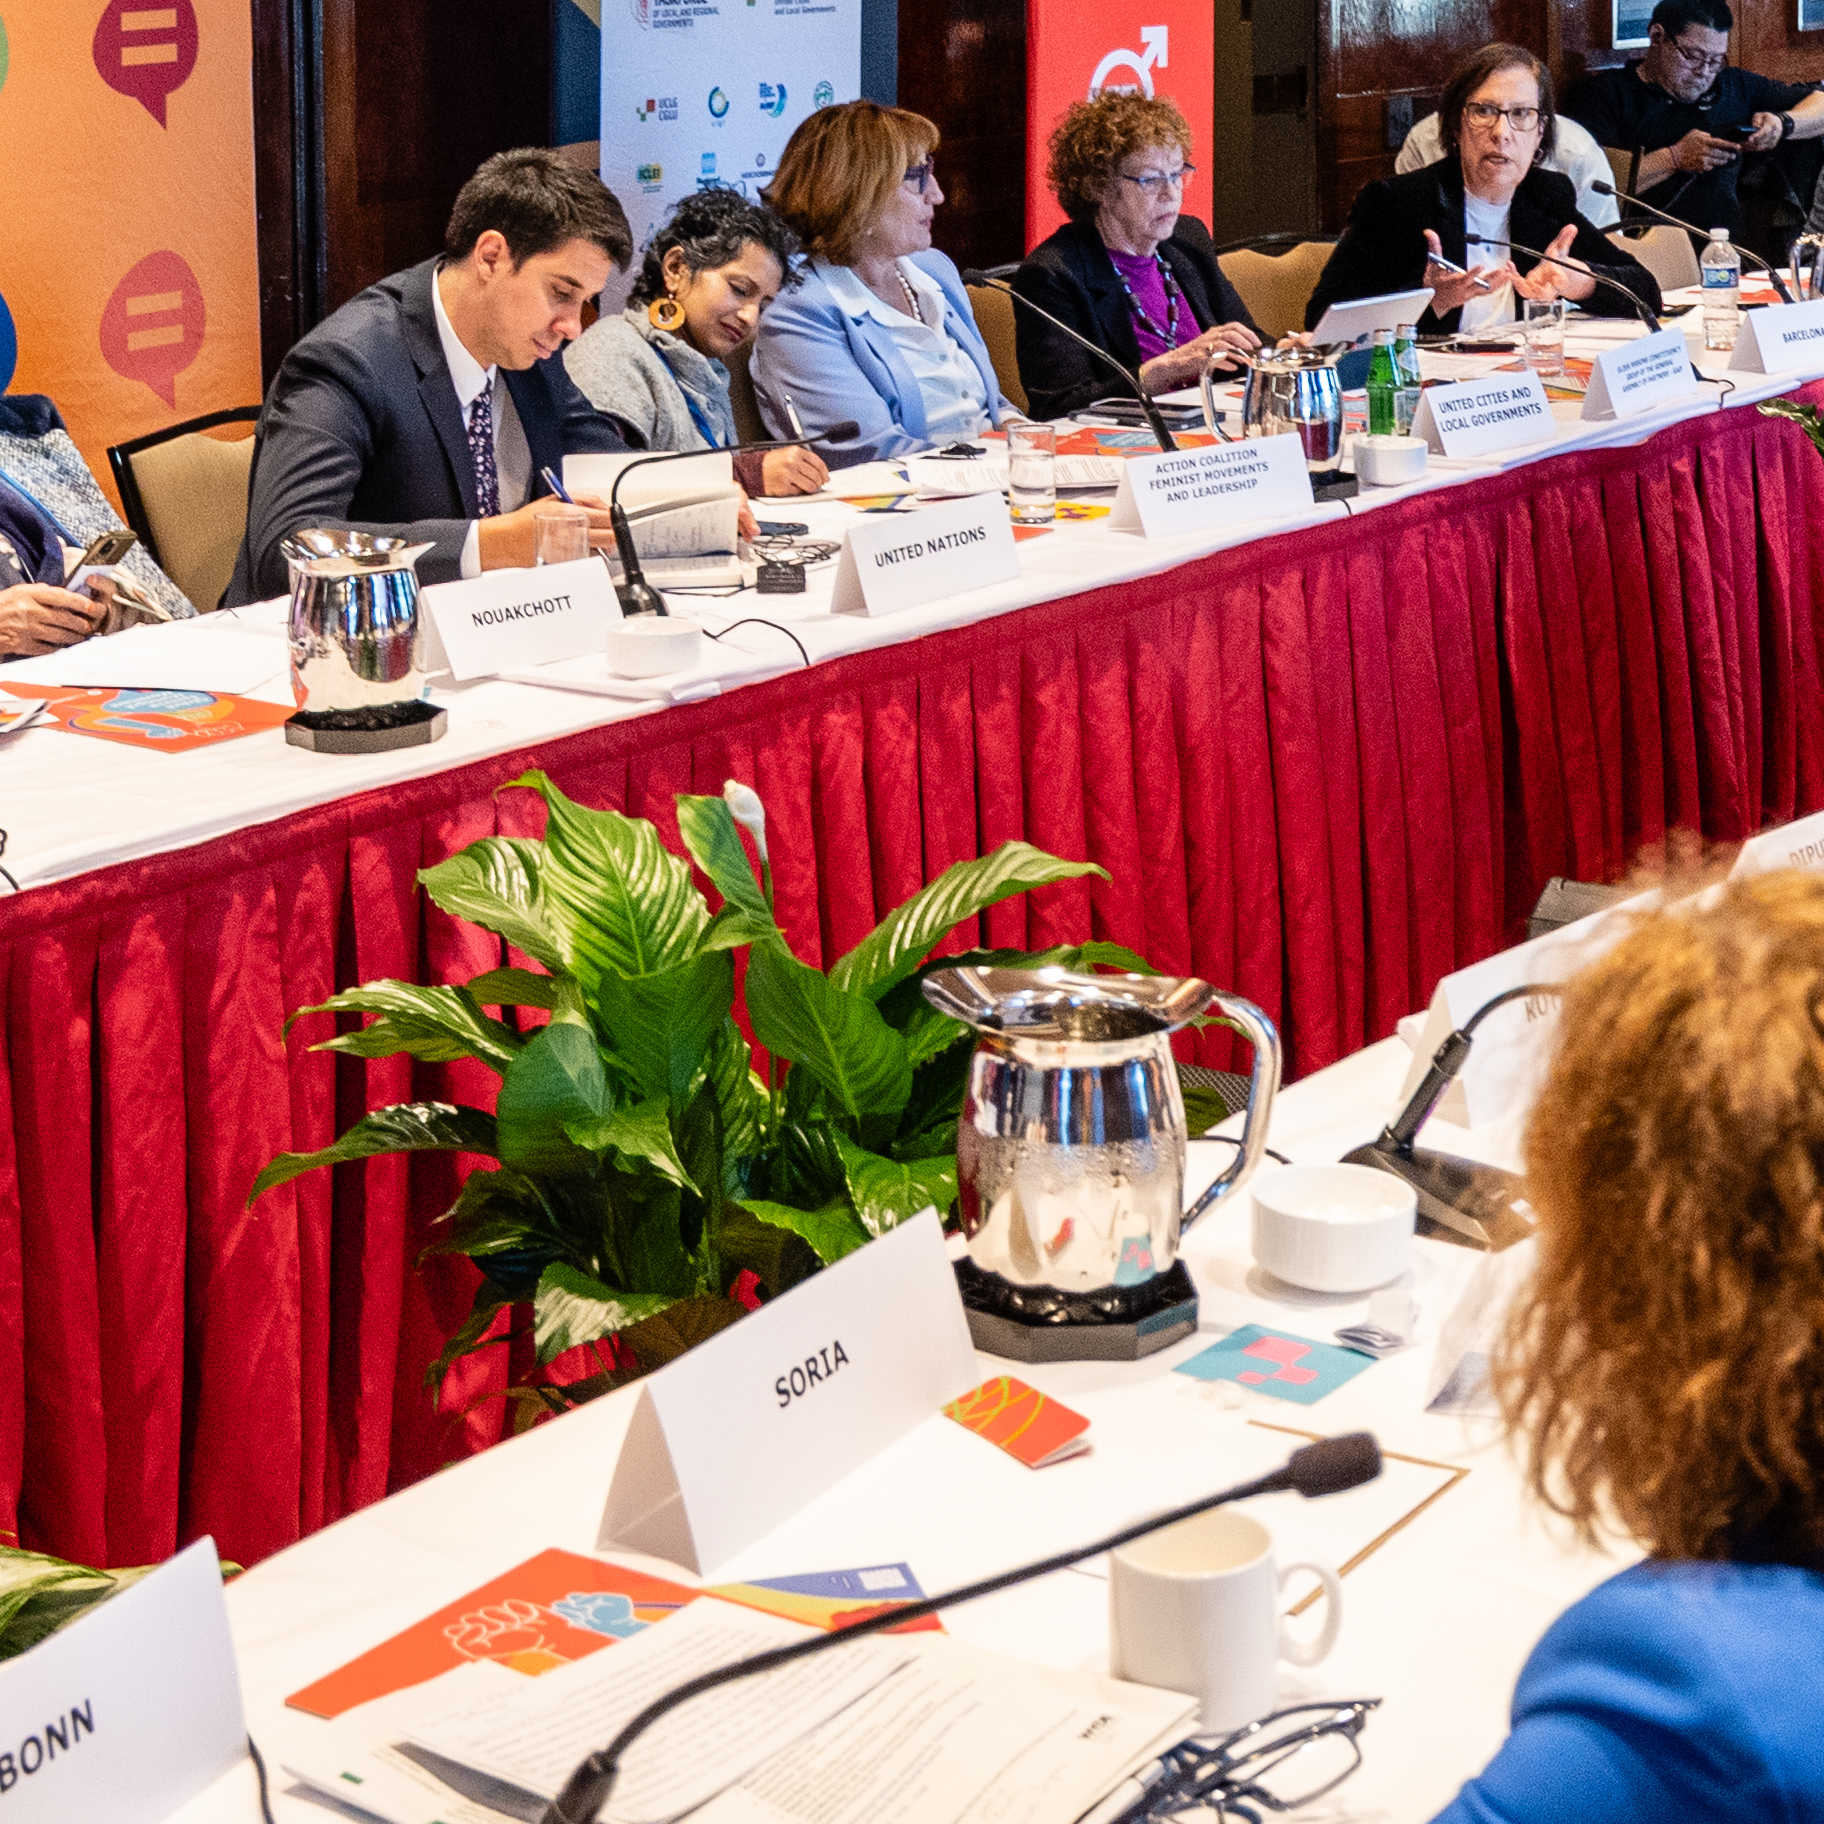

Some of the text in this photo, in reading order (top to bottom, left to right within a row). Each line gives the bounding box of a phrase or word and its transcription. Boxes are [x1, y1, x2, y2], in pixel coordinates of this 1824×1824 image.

[1439, 386, 1532, 415] UNITED CITIES AND
[1440, 402, 1543, 433] LOCAL GOVERNMENTS
[1149, 461, 1269, 491] FEMINIST MOVEMENTS
[1155, 448, 1259, 475] ACTION COALITION
[1166, 478, 1259, 504] AND LEADERSHIP
[875, 525, 987, 568] UNITED NATIONS
[471, 594, 573, 628] NOUAKCHOTT
[774, 1339, 850, 1409] SORIA
